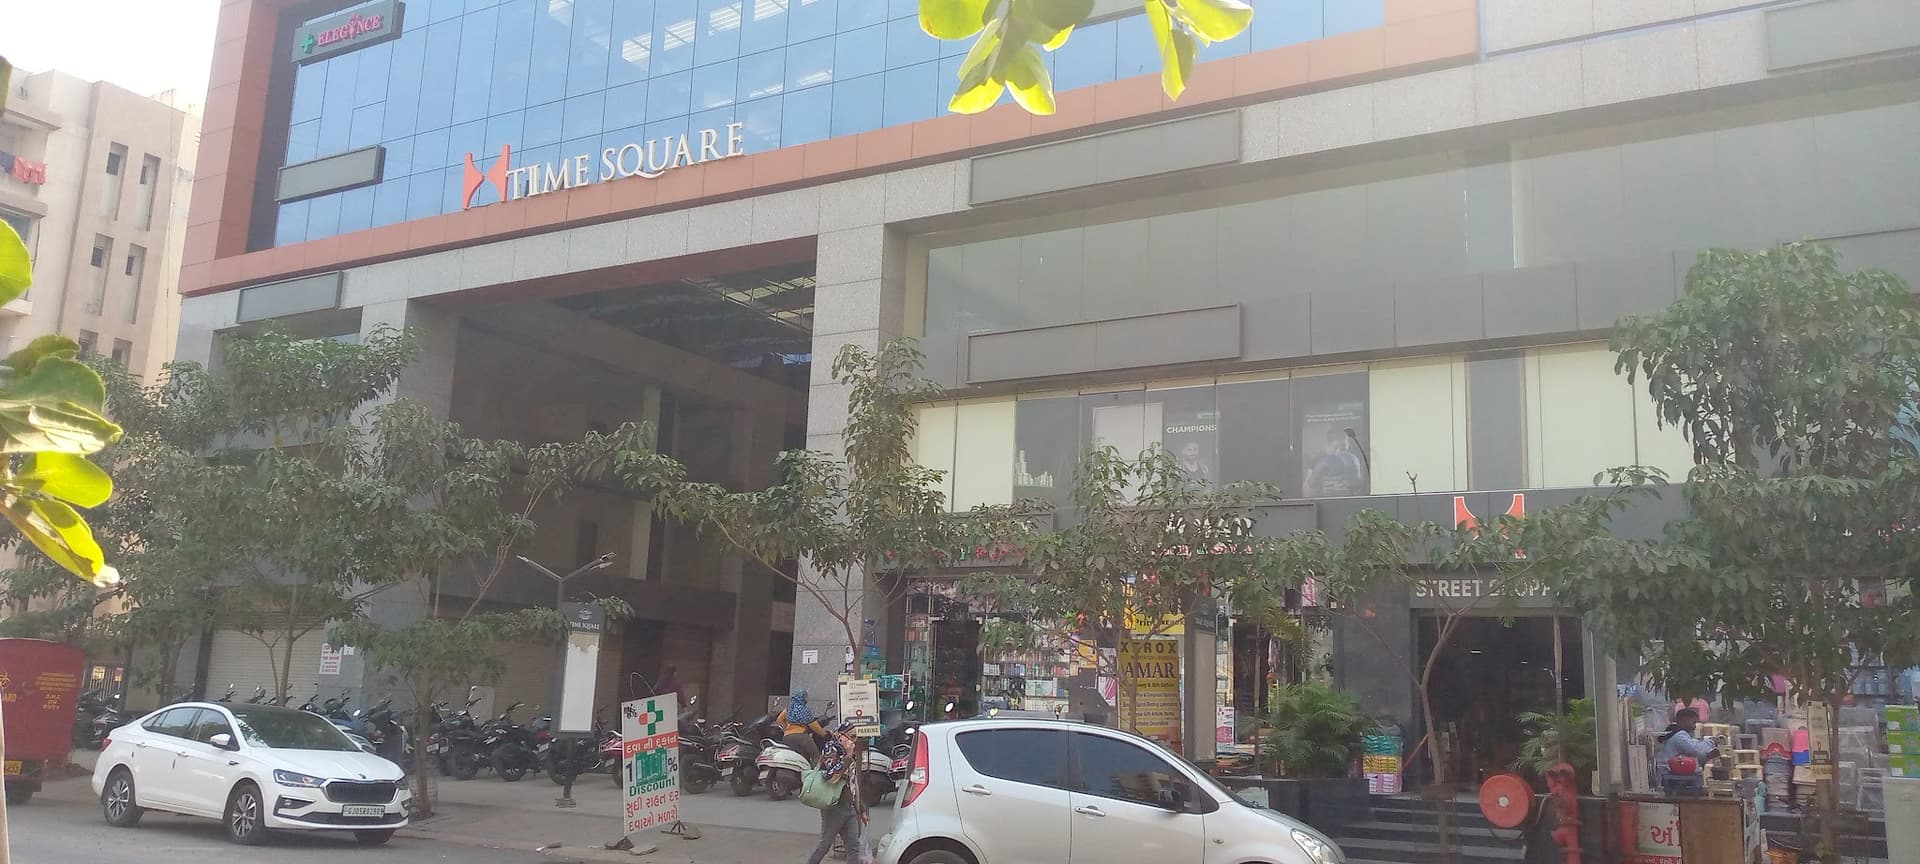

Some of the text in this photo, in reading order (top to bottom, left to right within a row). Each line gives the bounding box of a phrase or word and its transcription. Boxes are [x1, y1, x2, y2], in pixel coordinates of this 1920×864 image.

[505, 122, 744, 200] TIME SQUARE
[1166, 424, 1217, 434] CHAMPIONS
[1416, 580, 1482, 597] STREET
[857, 727, 879, 735] PARKING
[629, 778, 675, 797] Discount
[668, 790, 679, 803] દર
